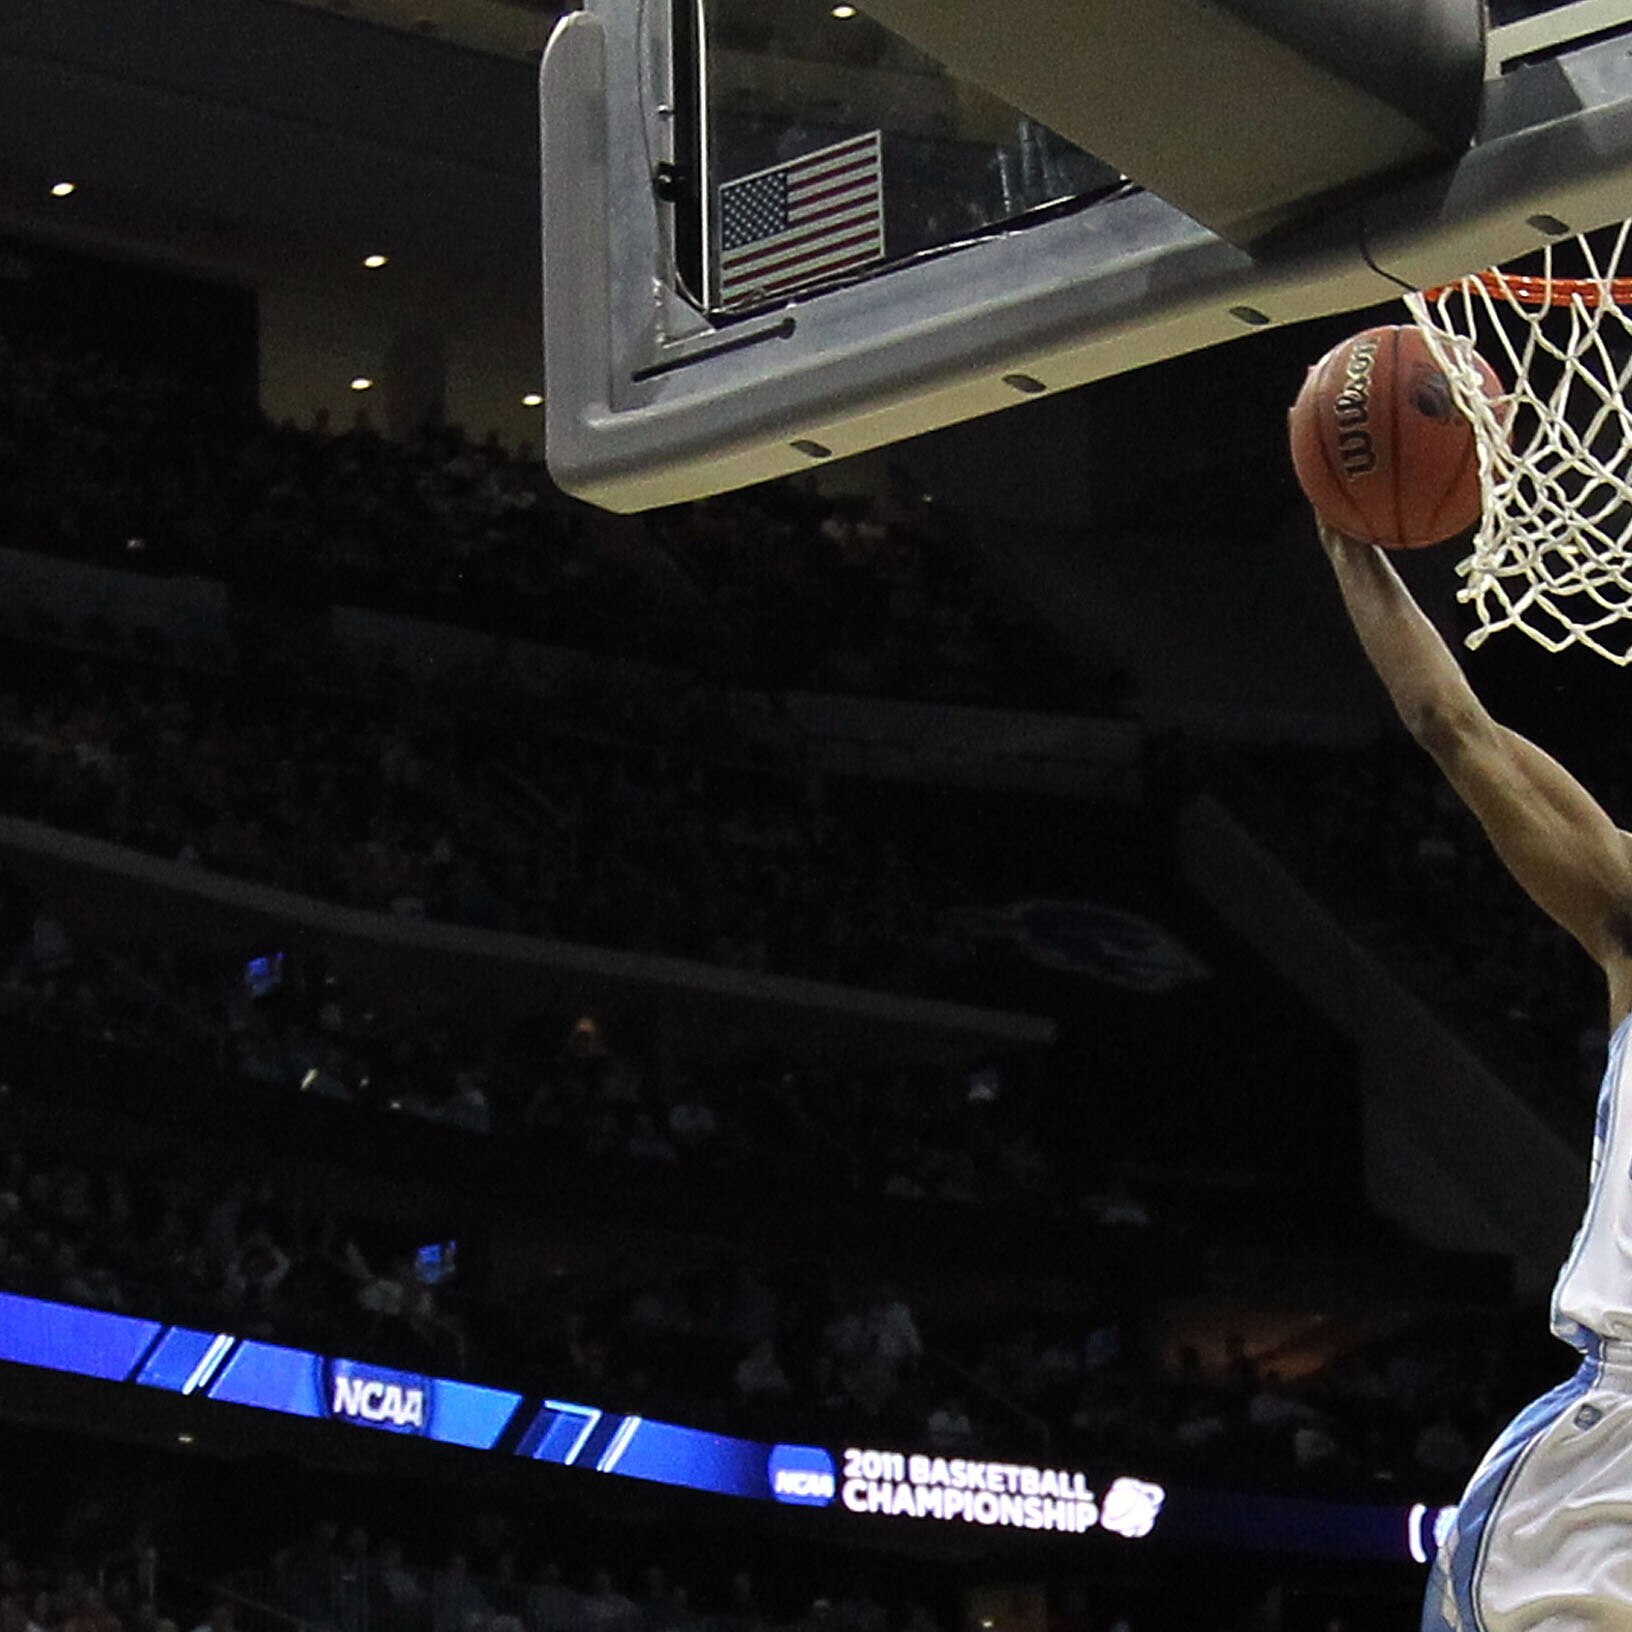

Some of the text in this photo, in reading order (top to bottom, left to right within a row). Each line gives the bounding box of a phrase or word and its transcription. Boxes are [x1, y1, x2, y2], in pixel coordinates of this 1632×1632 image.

[332, 1376, 424, 1428] NCAA
[843, 1447, 1095, 1502] 2011 BASKETBALL
[842, 1477, 1100, 1534] CHAMPIONSHIP
